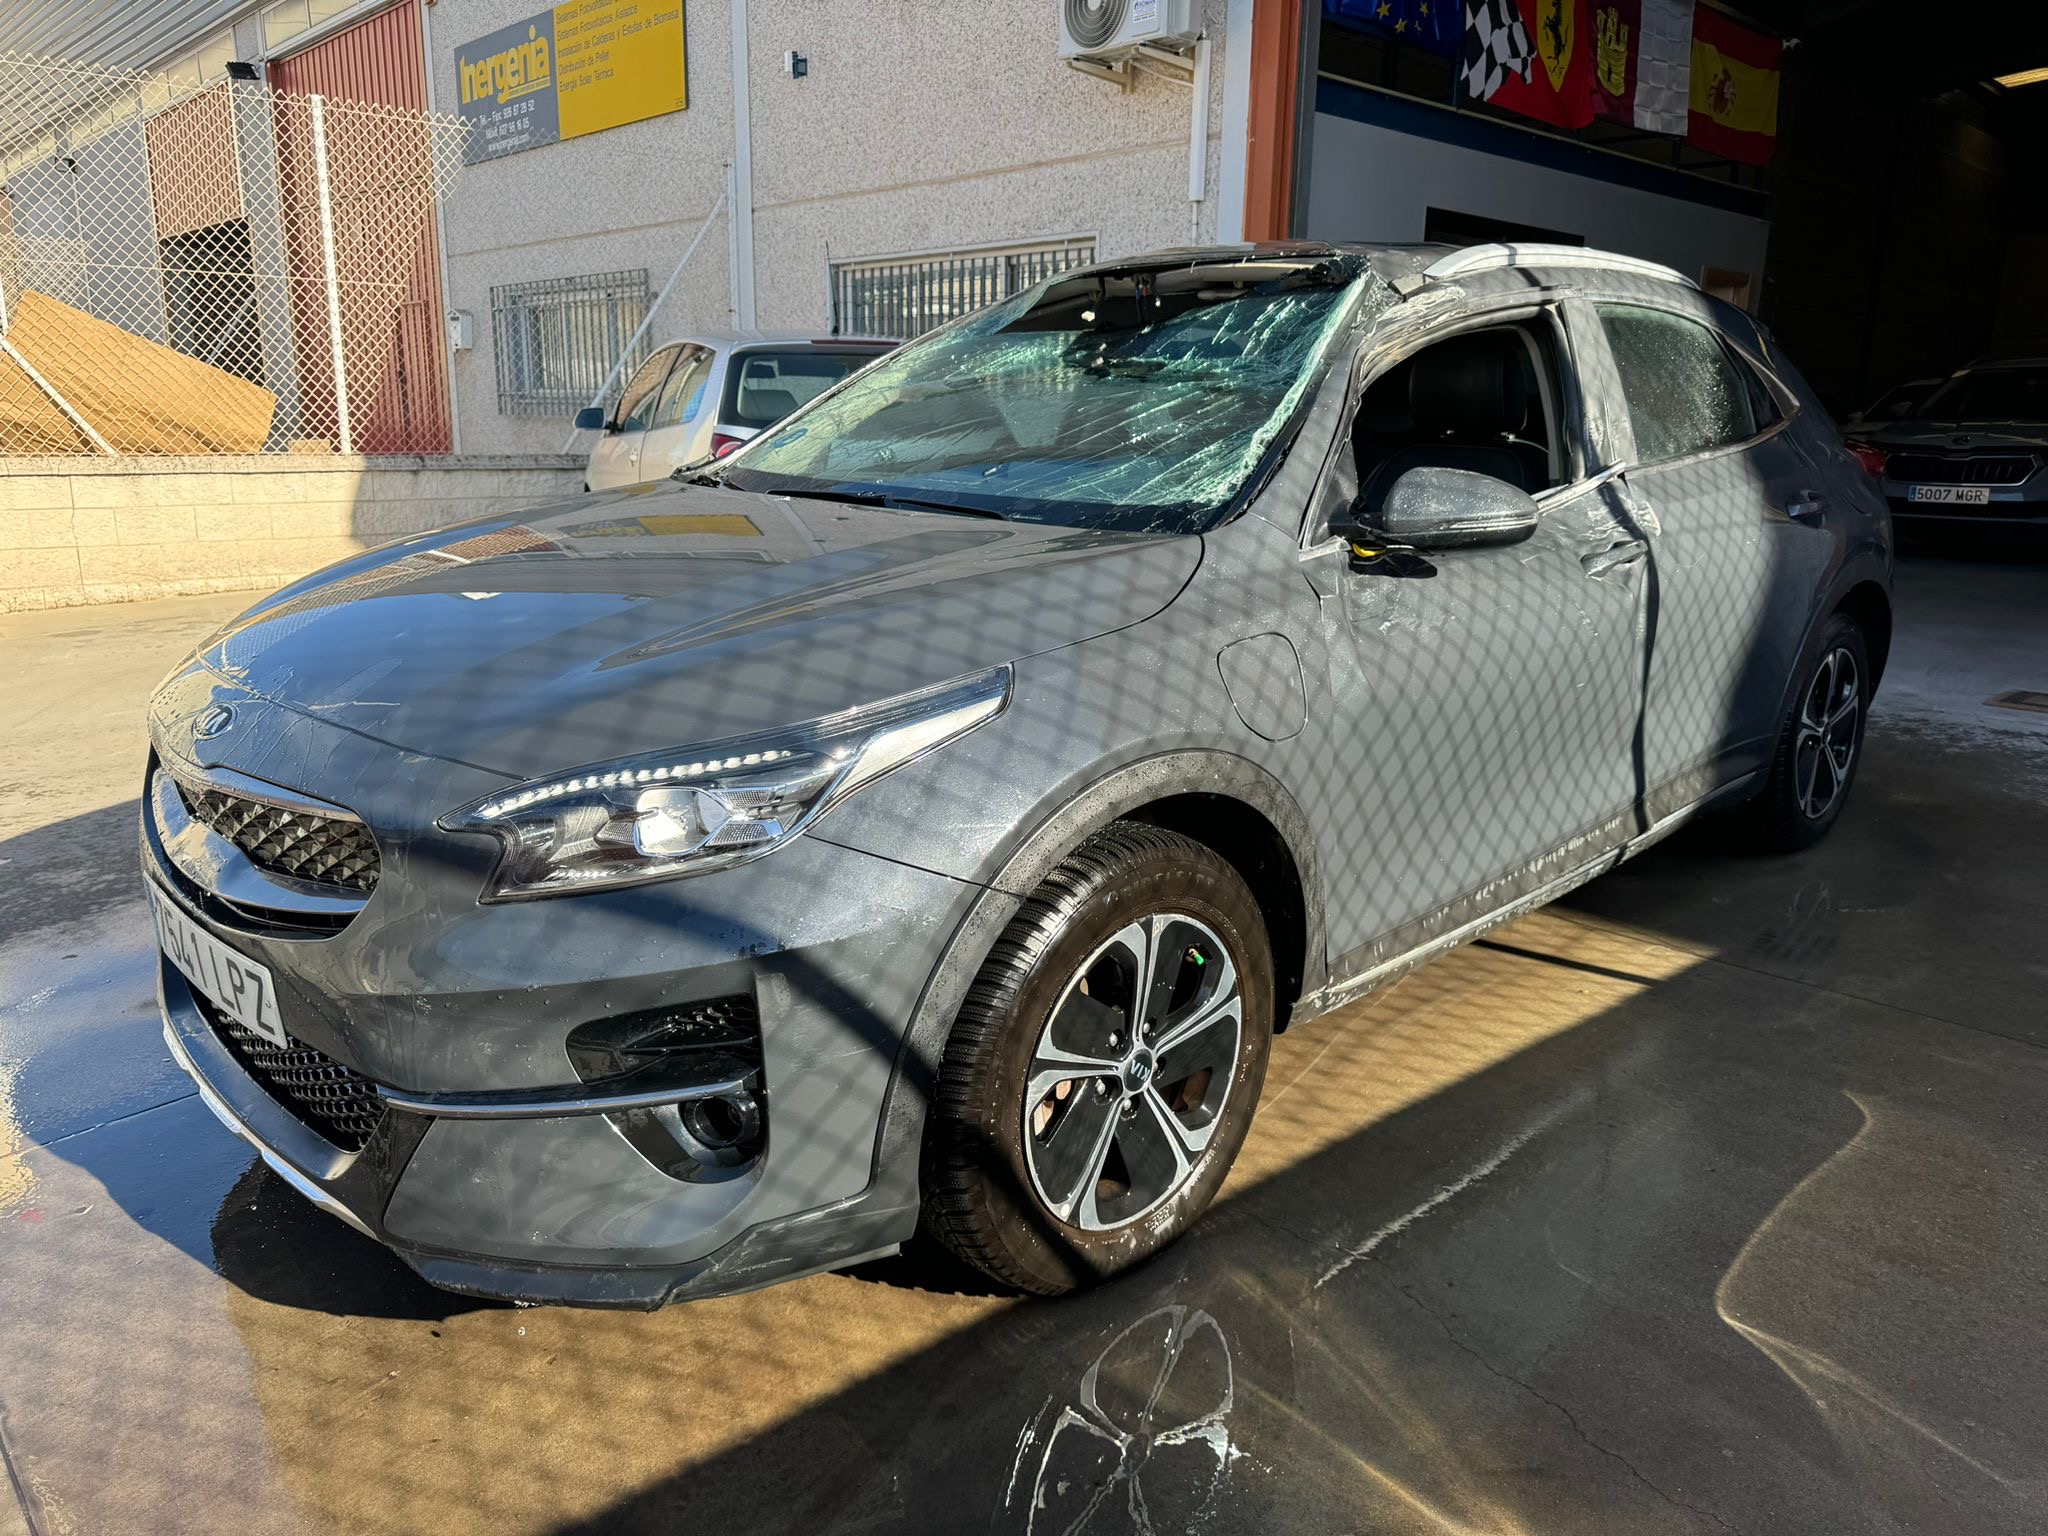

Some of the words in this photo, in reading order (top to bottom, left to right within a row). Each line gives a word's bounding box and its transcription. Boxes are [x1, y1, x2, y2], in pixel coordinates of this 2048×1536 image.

[645, 18, 653, 29] de
[1917, 487, 1951, 501] 5007
[1956, 489, 1983, 502] MGR
[208, 944, 276, 1036] LPZ
